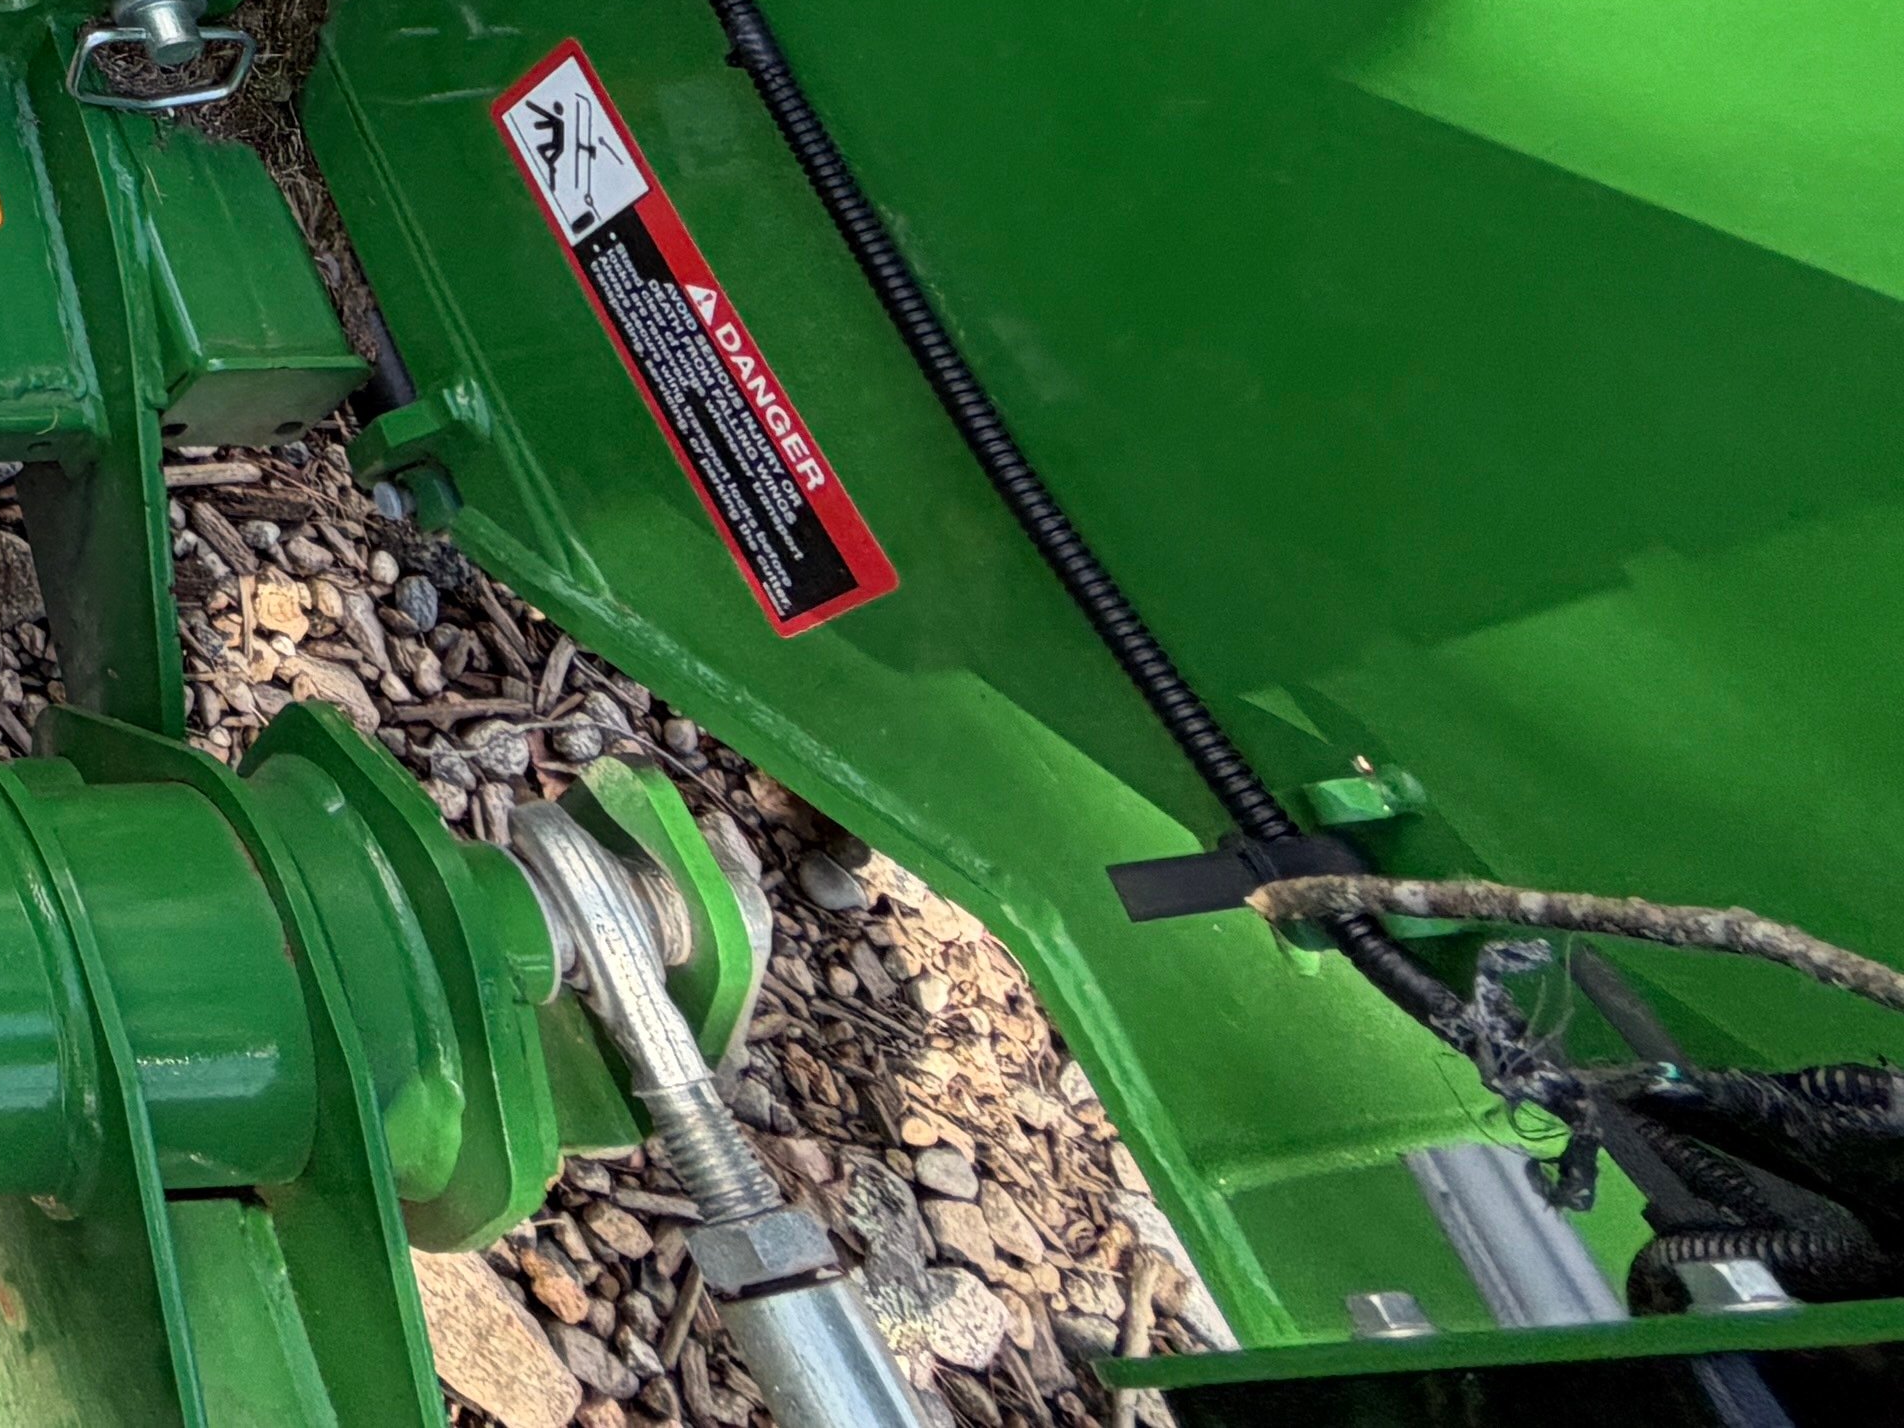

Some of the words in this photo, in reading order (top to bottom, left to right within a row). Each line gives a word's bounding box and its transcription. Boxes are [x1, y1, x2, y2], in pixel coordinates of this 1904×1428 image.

[596, 253, 633, 310] Always
[629, 308, 664, 363] secure
[657, 362, 687, 404] wing
[681, 404, 732, 482] transport
[727, 481, 760, 530] locks
[755, 530, 793, 588] before
[605, 247, 633, 290] locks
[629, 289, 649, 318] are
[645, 317, 692, 393] removed.
[613, 241, 645, 289] Stand
[640, 287, 669, 329] clear
[663, 327, 680, 348] of
[673, 347, 708, 398] wings
[704, 397, 756, 479] whenever
[749, 479, 804, 562] transport
[647, 277, 684, 334] DEATH
[679, 334, 715, 387] FROM
[711, 387, 760, 461] FALLING
[755, 462, 798, 526] WINGS
[662, 279, 698, 333] AVOID
[693, 332, 744, 410] SERIOUS
[739, 410, 784, 476] INJURY
[780, 477, 803, 508] OR
[713, 321, 828, 492] DANGER
